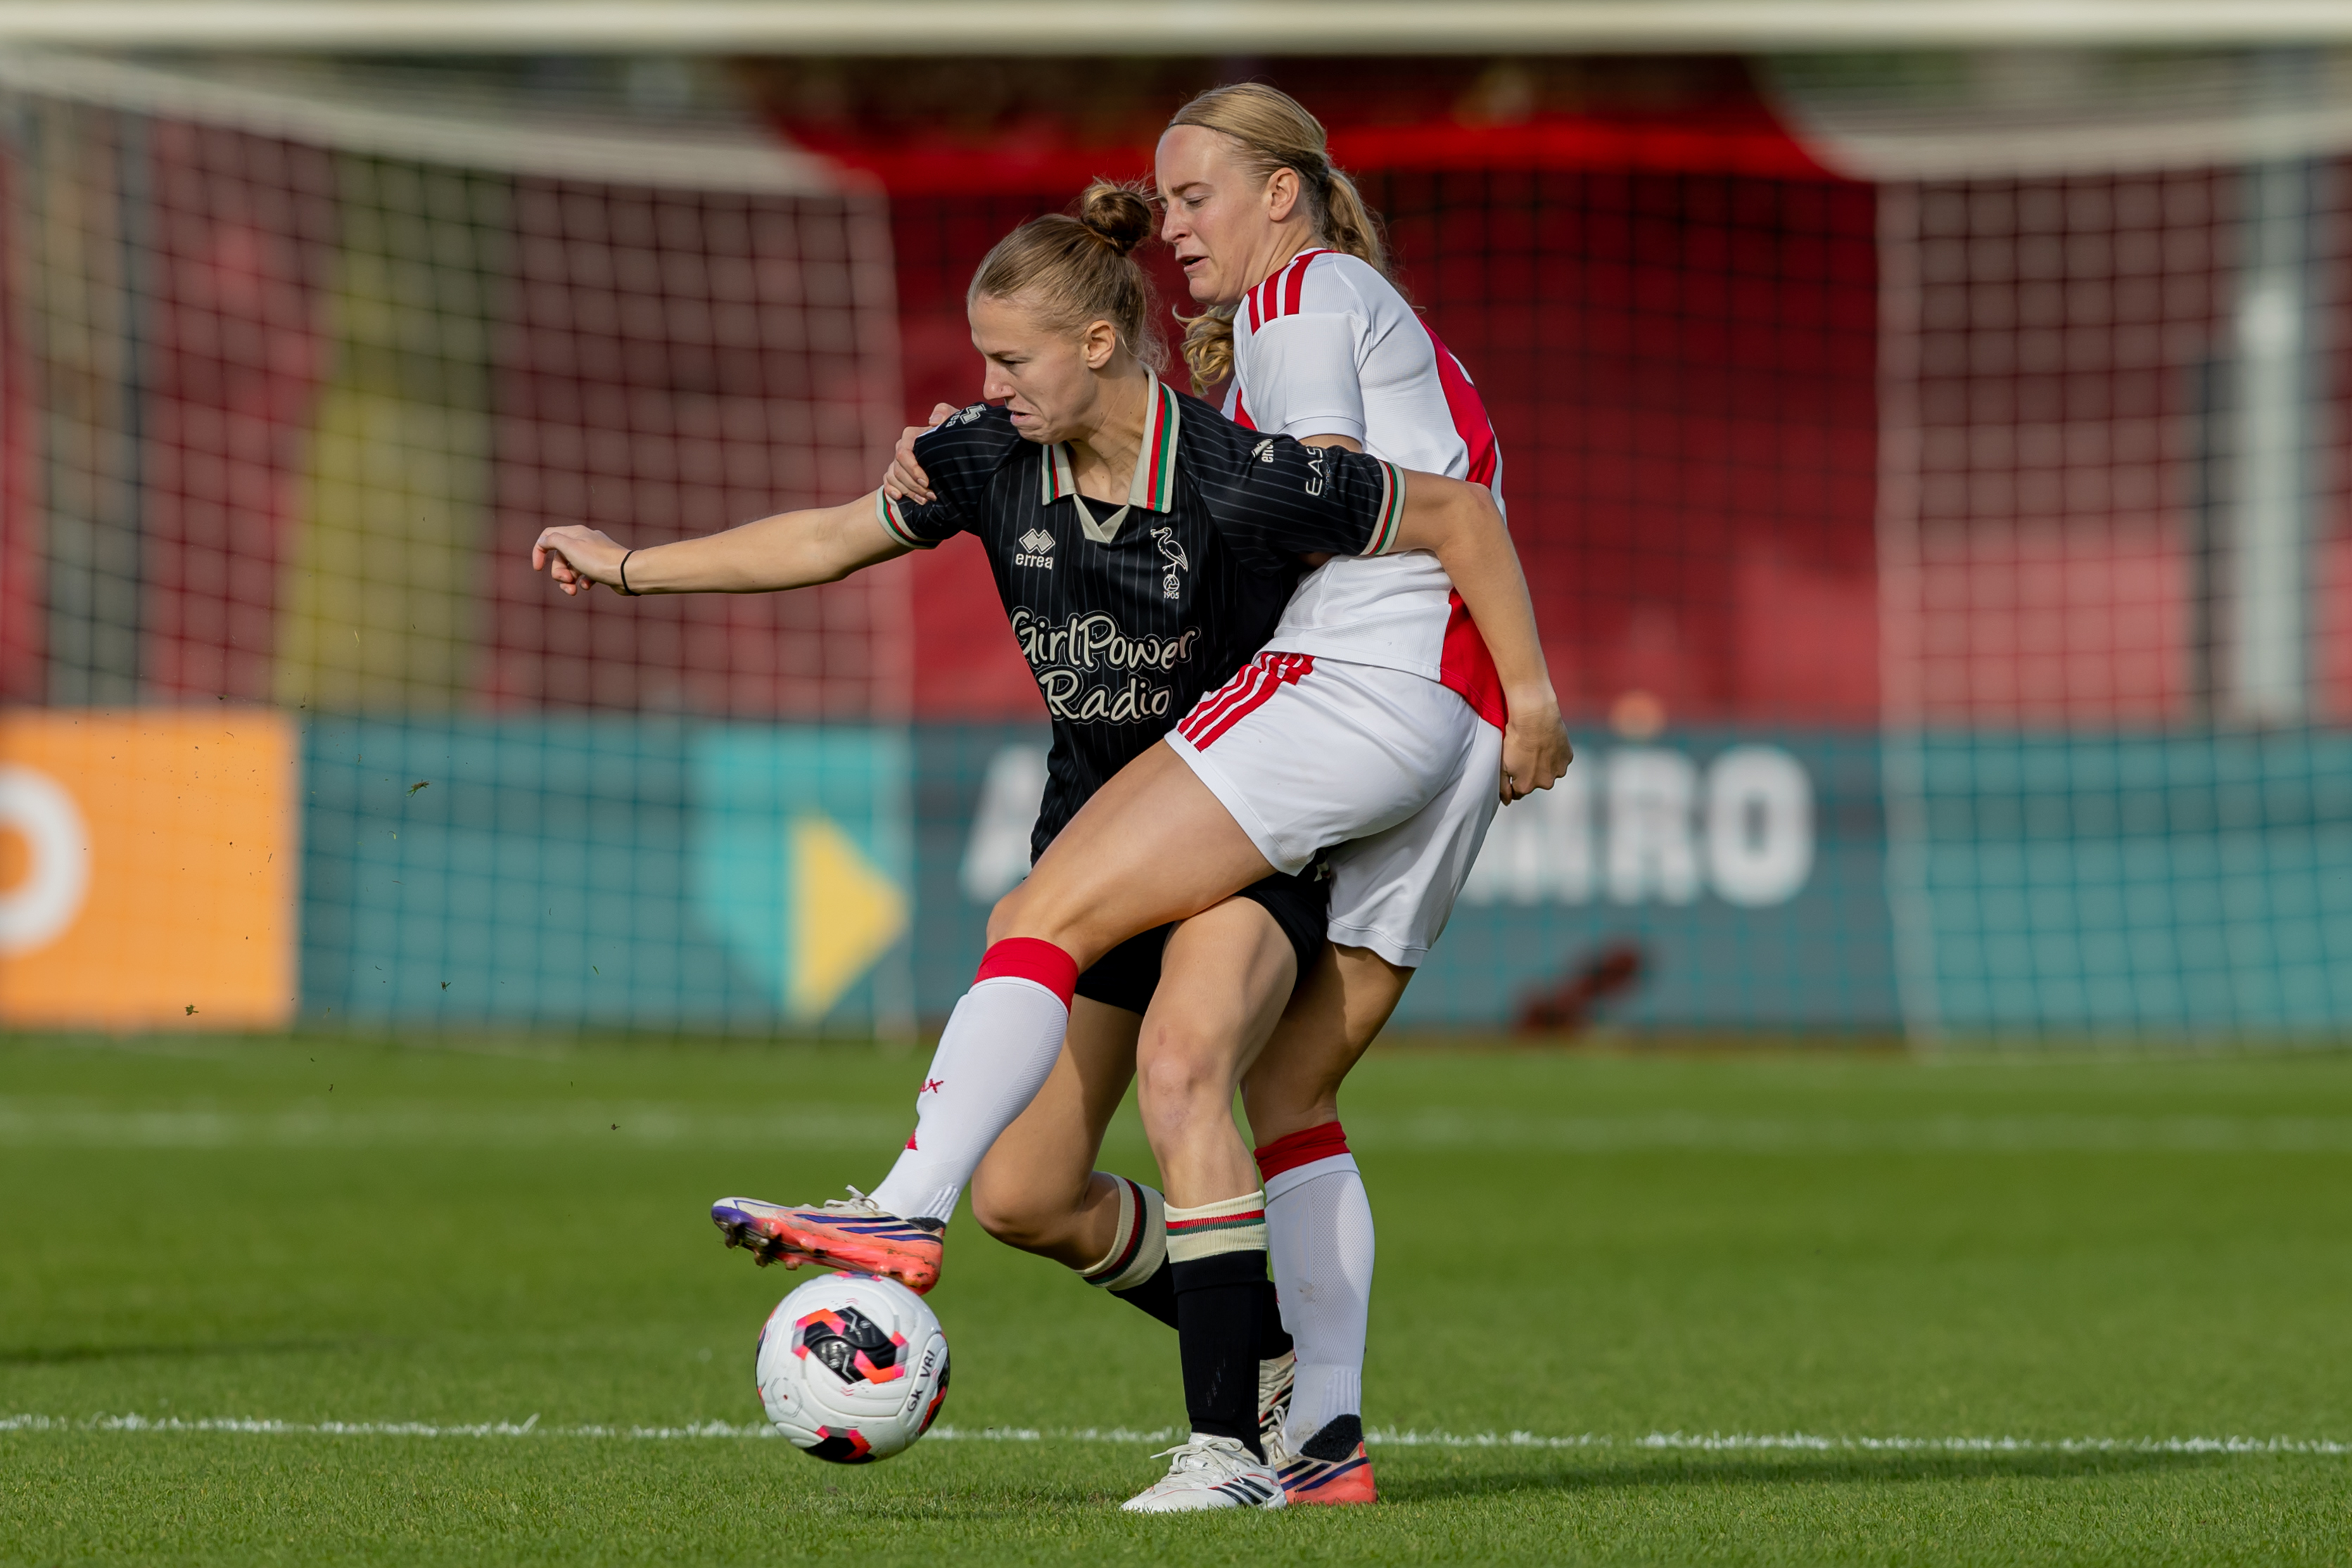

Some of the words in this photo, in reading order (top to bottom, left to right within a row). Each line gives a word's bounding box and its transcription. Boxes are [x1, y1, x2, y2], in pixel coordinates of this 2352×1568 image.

[1305, 444, 1323, 496] EAS
[1163, 590, 1180, 599] 1905
[1038, 670, 1170, 720] Radio
[907, 1389, 923, 1412] GK
